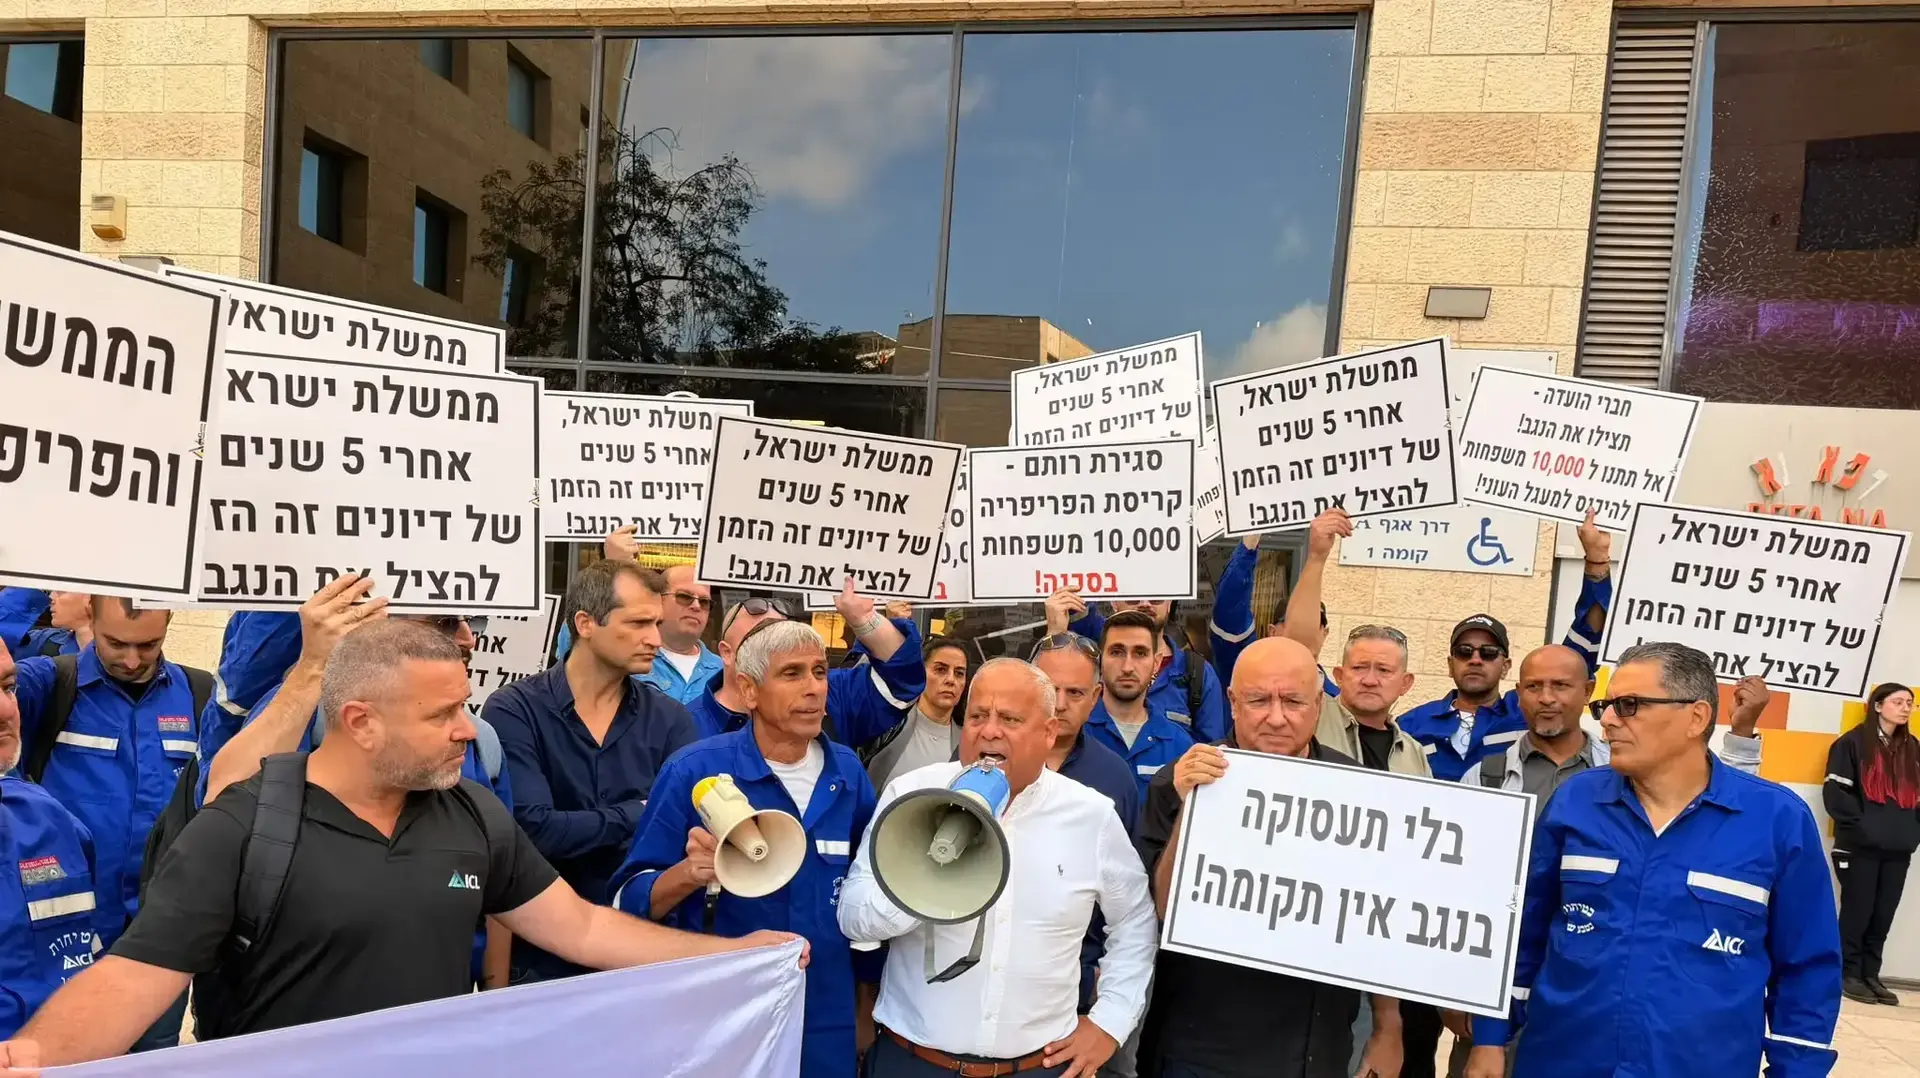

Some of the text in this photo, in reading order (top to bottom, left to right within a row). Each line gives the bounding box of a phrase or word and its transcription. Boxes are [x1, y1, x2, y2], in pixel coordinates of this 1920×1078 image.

[4, 302, 175, 395] הממש
[346, 317, 467, 367] ממשלת
[1034, 347, 1177, 395] ממשלת ישראל,
[226, 368, 499, 424] ממשלת ישרא
[1048, 377, 1165, 416] אחרי 5 שנים
[1239, 356, 1418, 417] ממשלת ישראל,
[1543, 387, 1592, 411] הועדה
[562, 399, 713, 431] משלת ישראל,
[1099, 408, 1156, 434] דיונים
[1161, 401, 1192, 421] של
[1597, 395, 1632, 418] חברי
[1071, 421, 1092, 440] זה
[1258, 401, 1404, 447] אחרי 5 שנים
[1516, 413, 1632, 452] תצילו את הנגב!
[220, 433, 324, 473] שנים
[342, 436, 365, 475] 5
[379, 445, 472, 482] אחרי
[580, 441, 712, 466] אחרי 5 שנים
[742, 427, 934, 477] ממשלת ישראל,
[1024, 454, 1081, 477] רותם
[1089, 449, 1163, 474] סגירת
[1462, 440, 1666, 493] אל תתנו ל 10,000 משפחות
[1232, 437, 1441, 497] של דיונים זה הזמן
[550, 478, 601, 504] הזמן
[609, 480, 633, 499] זה
[641, 481, 704, 501] דיונים
[758, 477, 910, 515] אחרי 5 שנים
[1354, 477, 1429, 512] להציל
[1474, 472, 1520, 500] העוני!
[1523, 480, 1573, 510] למעגל
[980, 493, 1095, 518] הפריפריה
[1103, 489, 1182, 518] קריסת
[1249, 500, 1306, 527] הנגב!
[1312, 492, 1347, 516] את
[209, 498, 522, 545] של דיונים זה הז
[566, 511, 702, 536] ציל את הנגב!
[717, 515, 774, 544] הזמן
[782, 522, 812, 545] זה
[1379, 518, 1413, 534] אגף
[1419, 520, 1451, 536] דרך
[818, 526, 890, 553] דיונים
[897, 528, 932, 556] של
[981, 533, 1083, 557] משפחות
[1093, 526, 1181, 559] 10,000
[1658, 513, 1871, 565] ממשלת ישראל,
[727, 553, 792, 584] הנגב!
[1367, 547, 1429, 565] קומה 1
[203, 562, 298, 597] הנגב
[386, 560, 501, 602] להציל
[798, 564, 835, 587] את
[842, 562, 912, 594] להציל
[1034, 569, 1119, 594] בסכנה!
[1670, 561, 1842, 604] אחרי 5 שנים
[1624, 597, 1866, 650] של דיונים זה הזמן
[471, 631, 508, 654] אח
[1711, 651, 1840, 688] להציל את
[1241, 788, 1464, 866] בלי תעסוקה
[465, 874, 481, 889] ICL
[1191, 853, 1493, 959] בנגב אין תקומה!
[49, 931, 91, 957] טיחות
